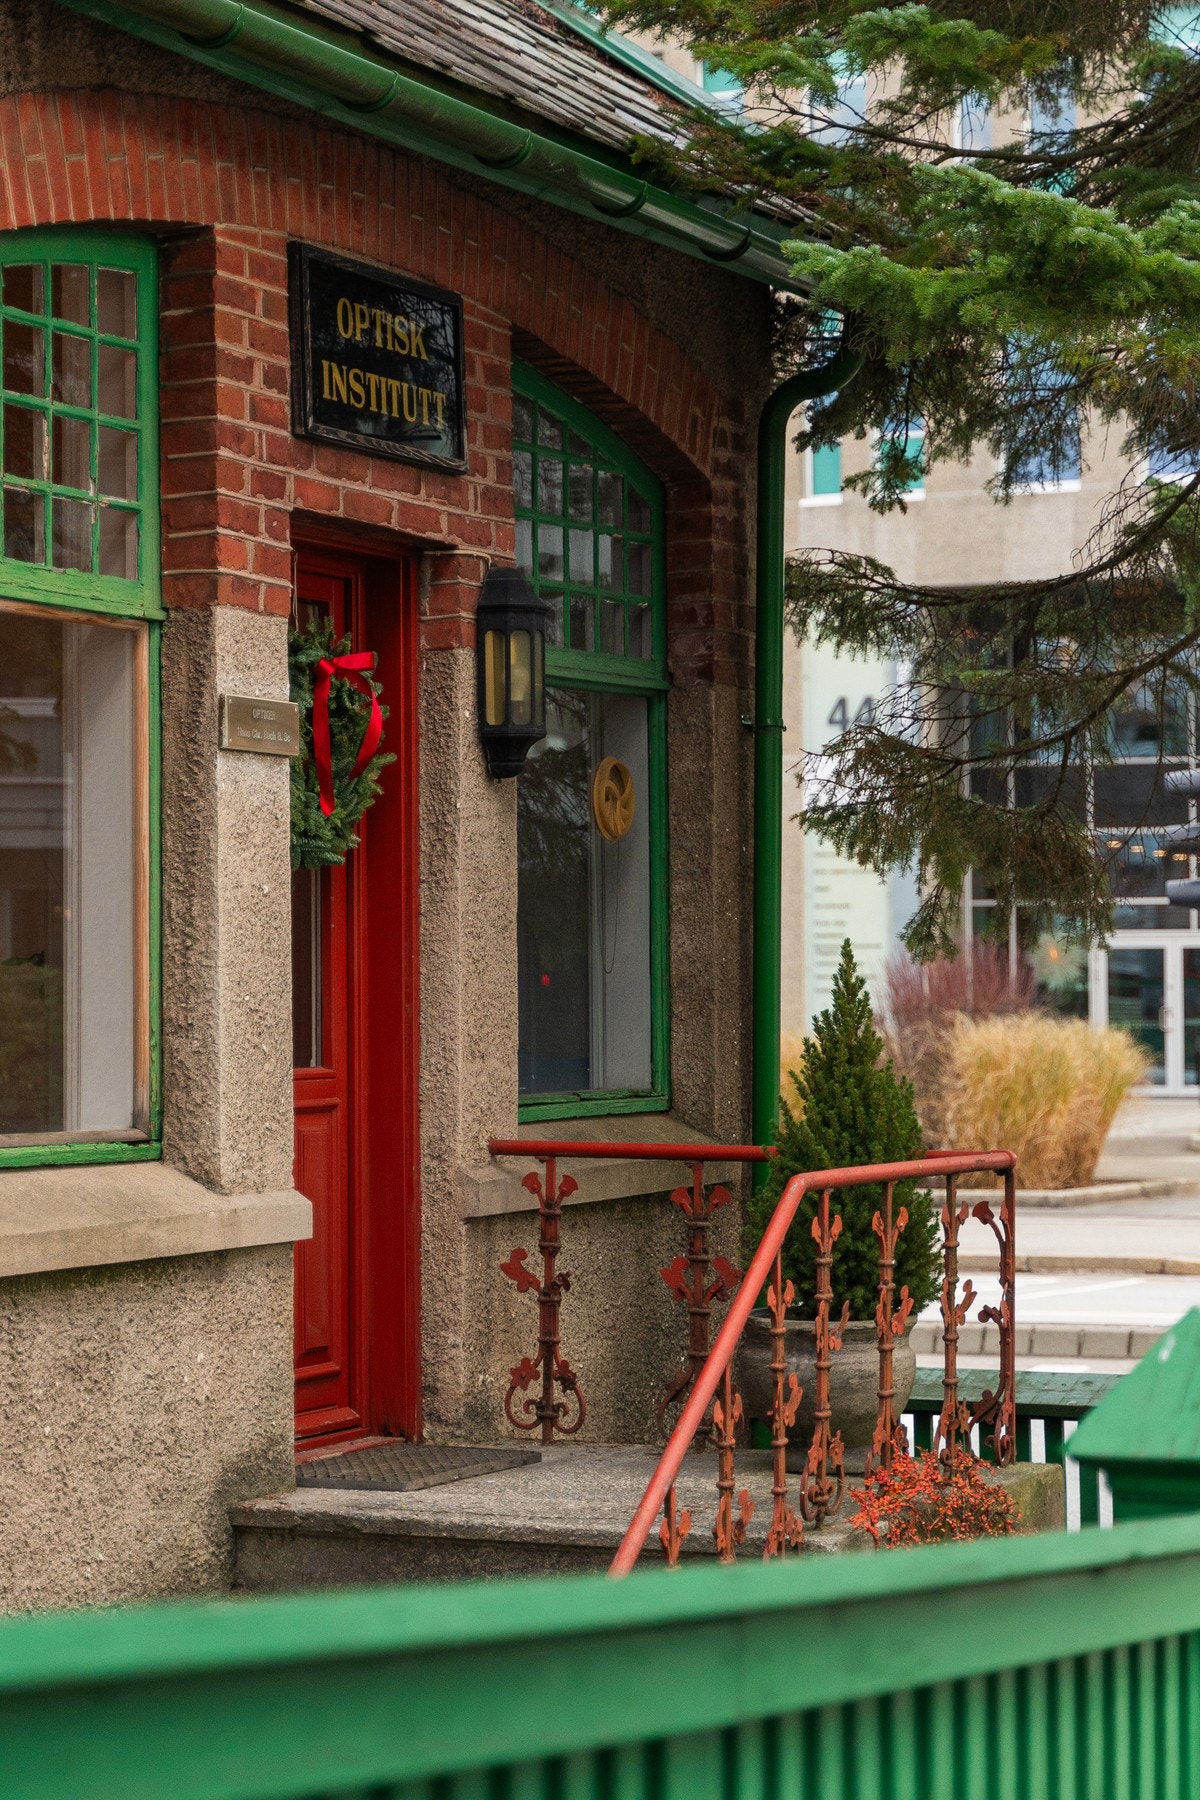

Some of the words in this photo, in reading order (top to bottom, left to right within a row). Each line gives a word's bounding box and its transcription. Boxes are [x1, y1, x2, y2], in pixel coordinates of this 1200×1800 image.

[336, 297, 428, 361] OPTISK
[321, 359, 446, 430] INSTITUTT
[828, 695, 876, 731] 44
